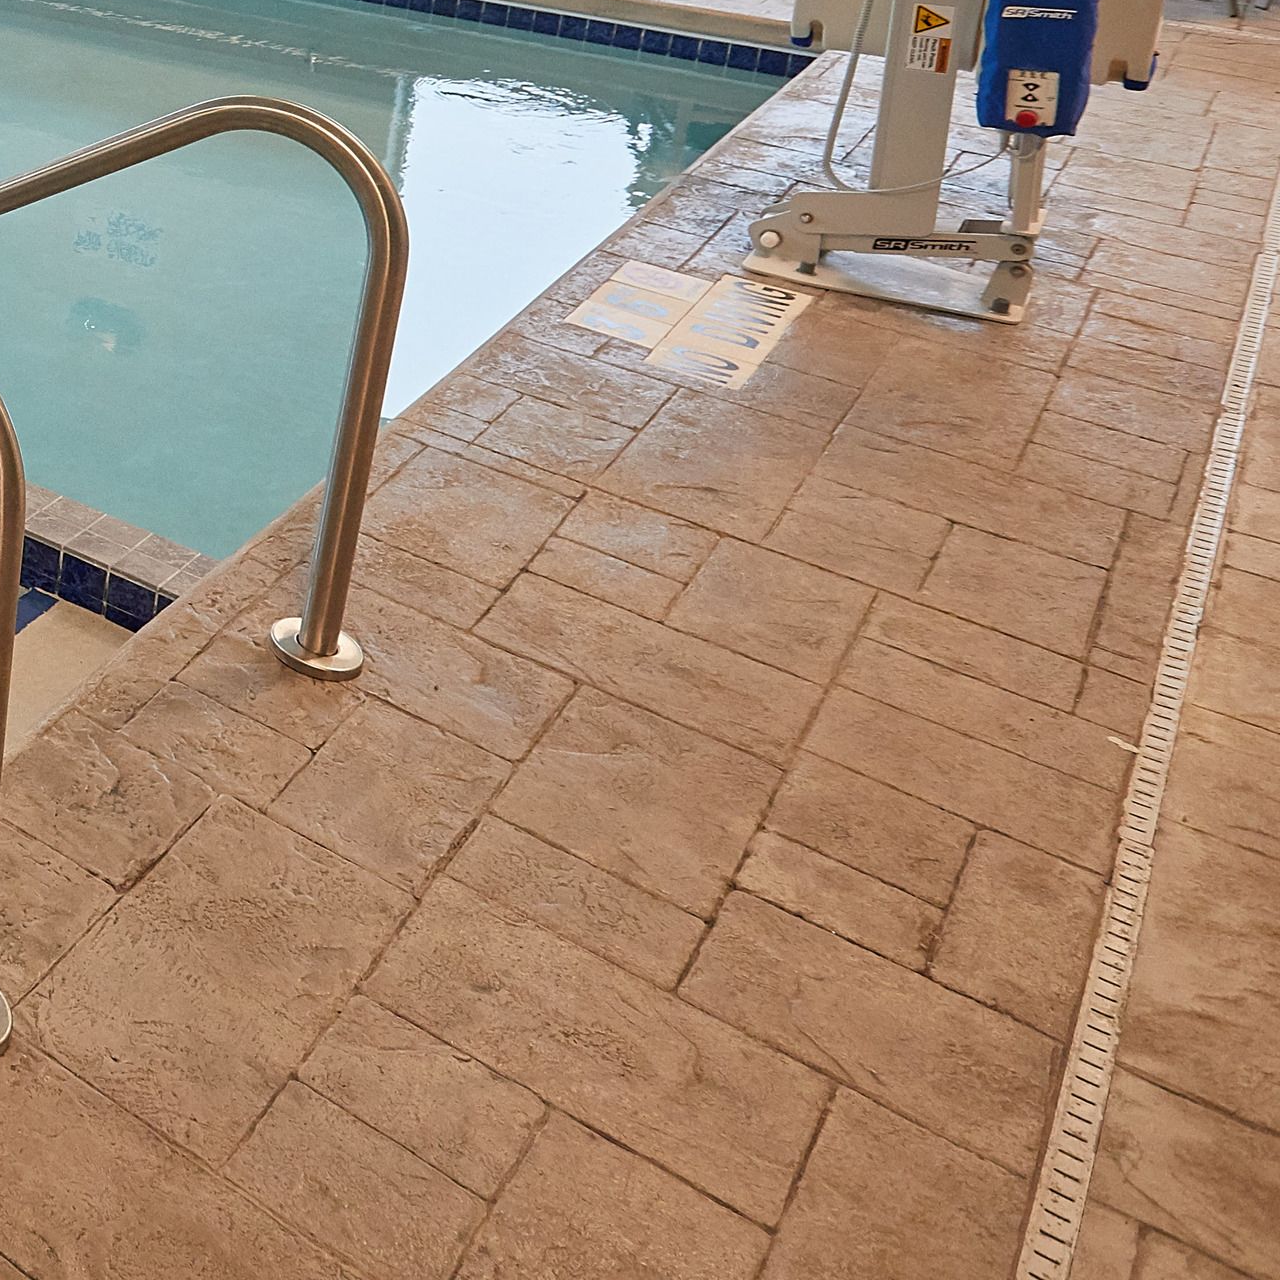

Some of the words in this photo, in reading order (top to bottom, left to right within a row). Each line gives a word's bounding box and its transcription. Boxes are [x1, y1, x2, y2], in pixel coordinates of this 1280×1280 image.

[1003, 7, 1026, 17] SR
[1027, 8, 1073, 20] Smith
[876, 240, 906, 250] SR
[910, 242, 971, 251] Smith
[692, 282, 798, 349] DIVING
[653, 346, 740, 385] NO
